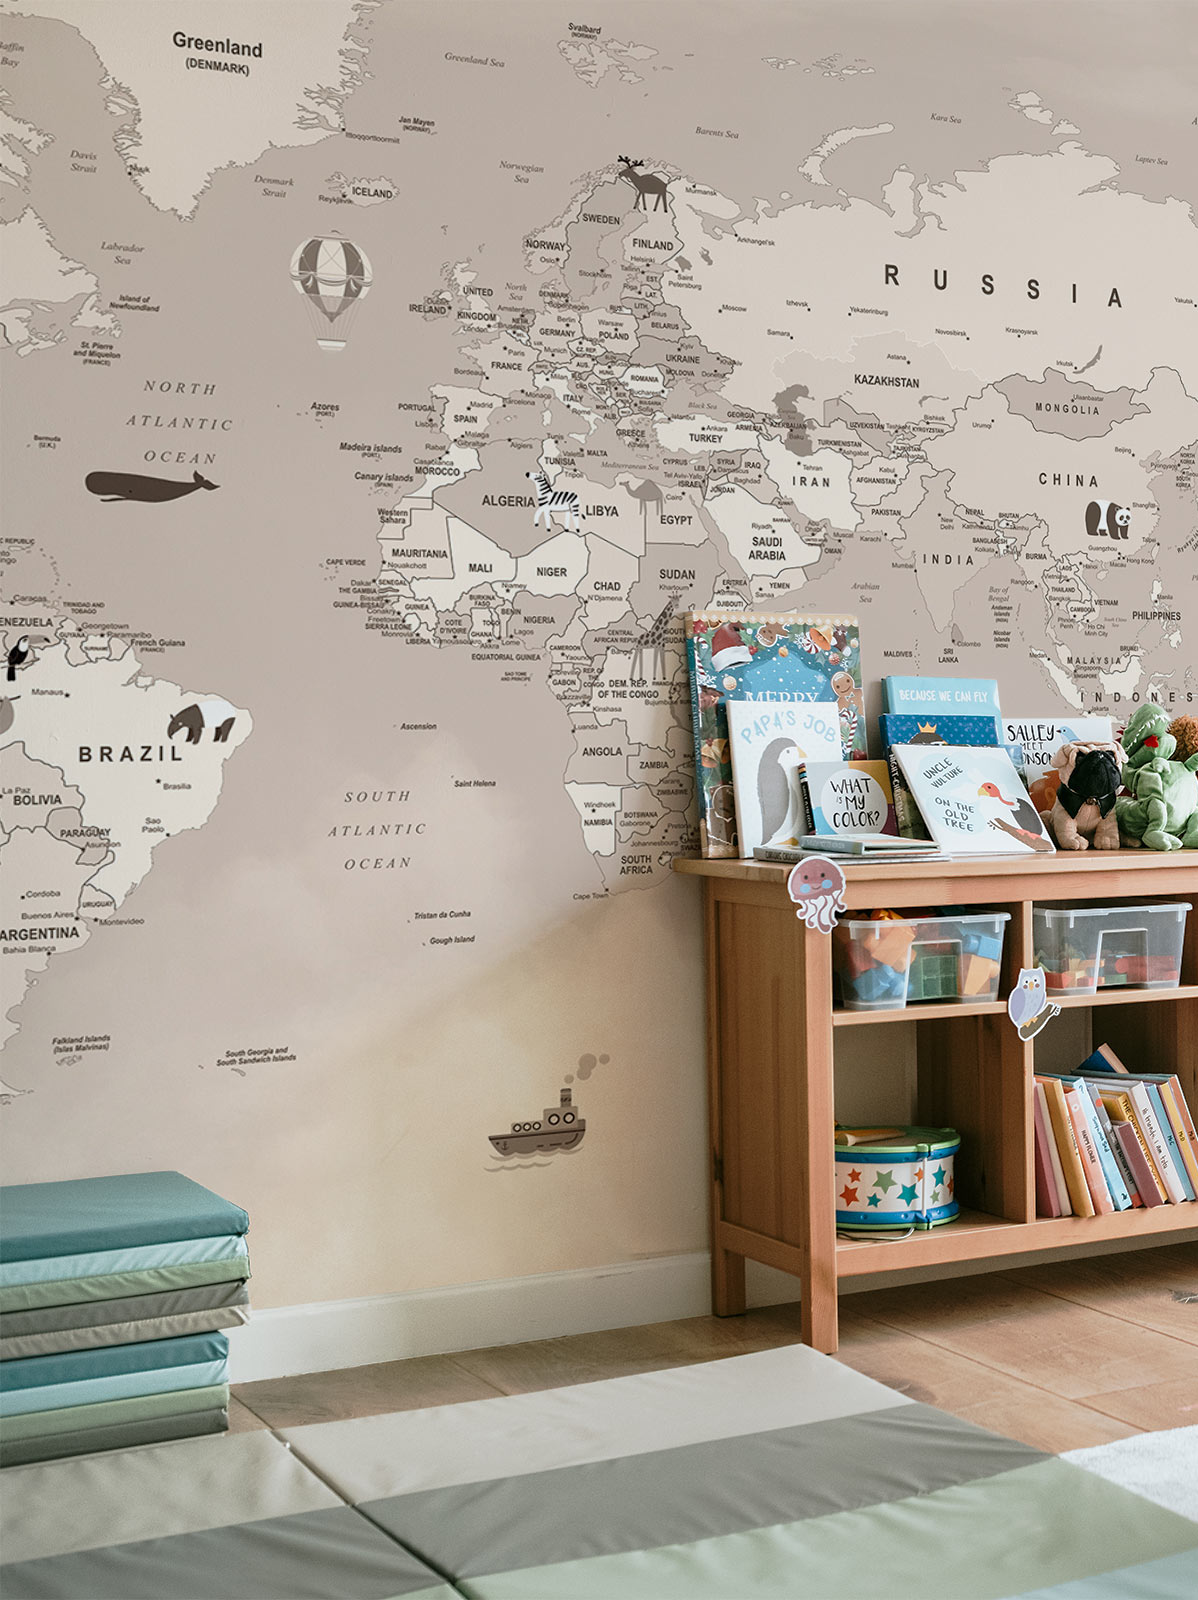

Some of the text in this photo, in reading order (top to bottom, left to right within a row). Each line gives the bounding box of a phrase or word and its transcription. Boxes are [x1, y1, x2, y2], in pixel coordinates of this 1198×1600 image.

[568, 23, 601, 35] Svalbard
[172, 32, 263, 58] Greenland
[445, 52, 505, 68] Greenland Sea
[185, 57, 250, 76] (DENMARK)
[931, 112, 962, 124] Kara Sea
[695, 127, 739, 139] Barents Sea
[70, 150, 97, 161] Davis
[70, 163, 97, 174] Strait
[499, 160, 544, 174] Norwegian
[254, 175, 294, 187] Denmark
[514, 175, 529, 184] Sea
[262, 188, 287, 199] Strait
[352, 187, 393, 199] ICELAND
[583, 213, 620, 225] SWEDEN
[101, 242, 145, 254] Labrador
[526, 239, 565, 251] NORWAY
[633, 238, 673, 250] FINLAND
[115, 256, 132, 265] Sea
[463, 286, 493, 296] UNITED
[885, 264, 1122, 308] RUSSIA
[409, 304, 446, 314] IRELAND
[722, 304, 747, 312] Moscow
[457, 311, 496, 321] KINGDOM
[539, 328, 575, 337] GERMANY
[599, 331, 629, 341] POLAND
[767, 329, 790, 337] Samara
[935, 328, 966, 336] Novosibirsk
[666, 354, 700, 364] UKRAINE
[491, 362, 522, 370] FRANCE
[631, 375, 659, 383] ROMANIA
[854, 374, 919, 388] KAZAKHSTAN
[143, 381, 217, 396] NORTH
[563, 394, 583, 402] ITALY
[311, 402, 339, 412] Azores
[398, 403, 436, 412] PORTUGAL
[1036, 403, 1099, 415] MONGOLIA
[126, 415, 233, 431] ATLANTIC
[454, 415, 477, 423] SPAIN
[616, 429, 645, 437] GREECE
[690, 433, 722, 443] TURKEY
[340, 443, 402, 453] Madeira islands
[144, 451, 216, 464] OCEAN
[545, 457, 576, 465] TUNISIA
[355, 472, 413, 482] Canary islands
[415, 467, 460, 476] MOROCCO
[793, 476, 829, 487] IRAN
[1039, 473, 1098, 487] CHINA
[482, 495, 535, 507] ALGERIA
[586, 506, 618, 517] LIBYA
[661, 515, 692, 525] EGYPT
[753, 537, 782, 547] SAUDI
[392, 549, 448, 558] MAURITANIA
[749, 550, 786, 560] ARABIA
[924, 554, 973, 565] INDIA
[469, 564, 492, 573] MALI
[537, 568, 567, 577] NIGER
[660, 569, 695, 579] SUDAN
[594, 582, 621, 591] CHAD
[1132, 611, 1181, 621] PHILIPPINES
[1067, 657, 1121, 665] MALAYSIA
[745, 691, 819, 702] MERRY
[899, 690, 988, 702] BECAUSE WE CAN FLY
[689, 671, 701, 761] MERRY CHRISTMAS
[741, 711, 836, 744] PAPA'S JOB
[1008, 724, 1055, 742] SALLEY
[583, 747, 622, 756] ANGOLA
[1020, 742, 1043, 750] MEET
[79, 746, 182, 762] BRAZIL
[923, 757, 953, 779] UNCLE
[931, 766, 963, 788] VULTURE
[830, 778, 871, 794] WHAT
[14, 795, 62, 805] BOLIVIA
[344, 791, 410, 802] SOUTH
[846, 795, 865, 810] MY
[935, 797, 974, 814] ON THE
[834, 811, 879, 827] COLOR?
[946, 810, 969, 821] OLD
[328, 823, 426, 837] ATLANTIC
[943, 817, 973, 832] TREE
[344, 857, 411, 870] OCEAN
[621, 855, 651, 864] SOUTH
[620, 866, 652, 875] AFRICA
[26, 890, 60, 898] Cordoba
[0, 927, 80, 941] ARGENTINA
[430, 935, 475, 946] Gough Island
[52, 1034, 111, 1047] Falkland Islands
[1122, 1099, 1131, 1114] THE
[1128, 1115, 1143, 1145] CHICKEN
